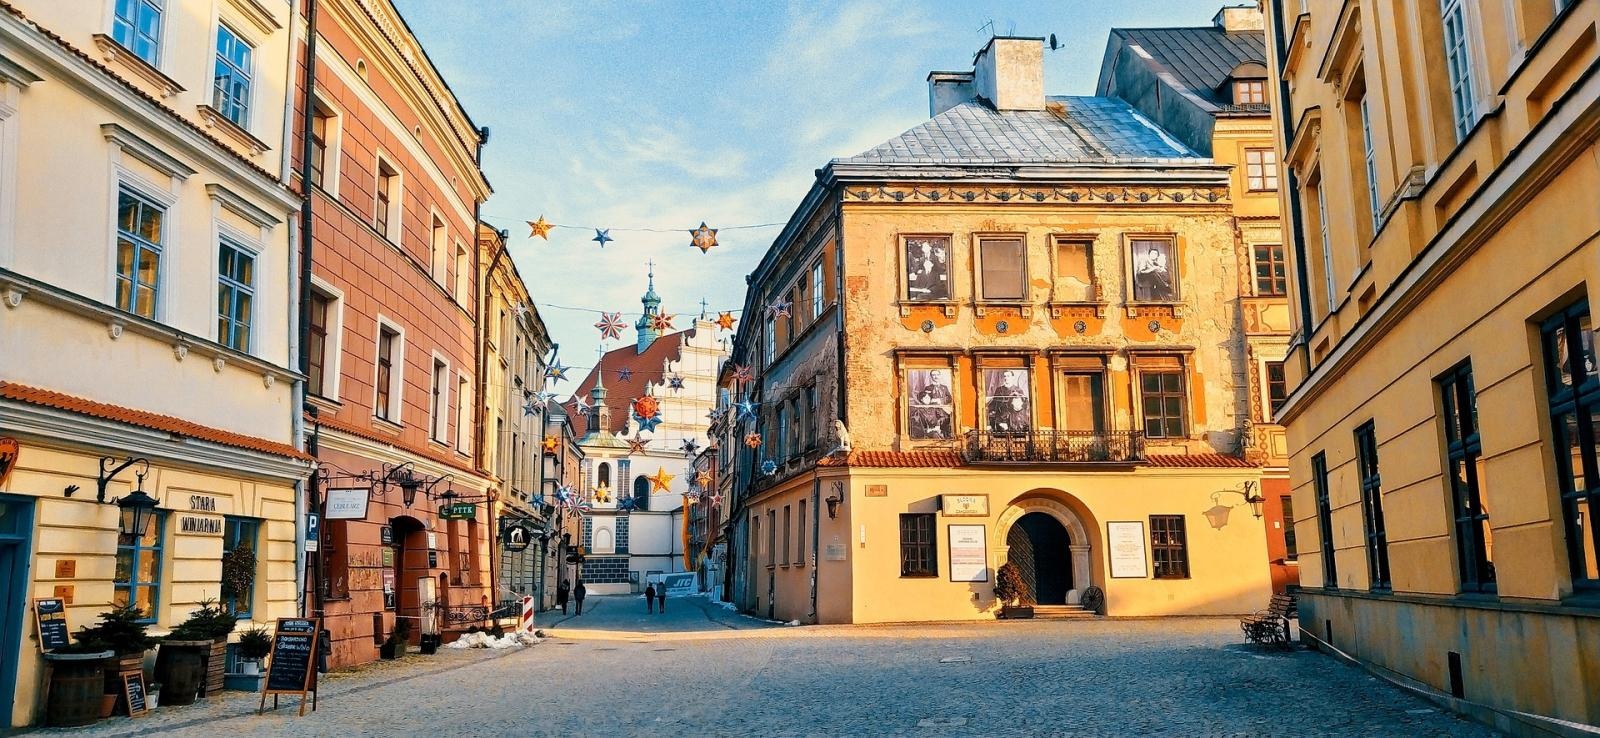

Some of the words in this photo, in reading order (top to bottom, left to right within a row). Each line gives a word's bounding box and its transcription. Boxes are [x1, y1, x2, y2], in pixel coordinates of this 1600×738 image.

[190, 495, 216, 511] STARA
[453, 506, 473, 514] PTTK
[309, 515, 317, 532] P
[673, 578, 692, 587] JTC
